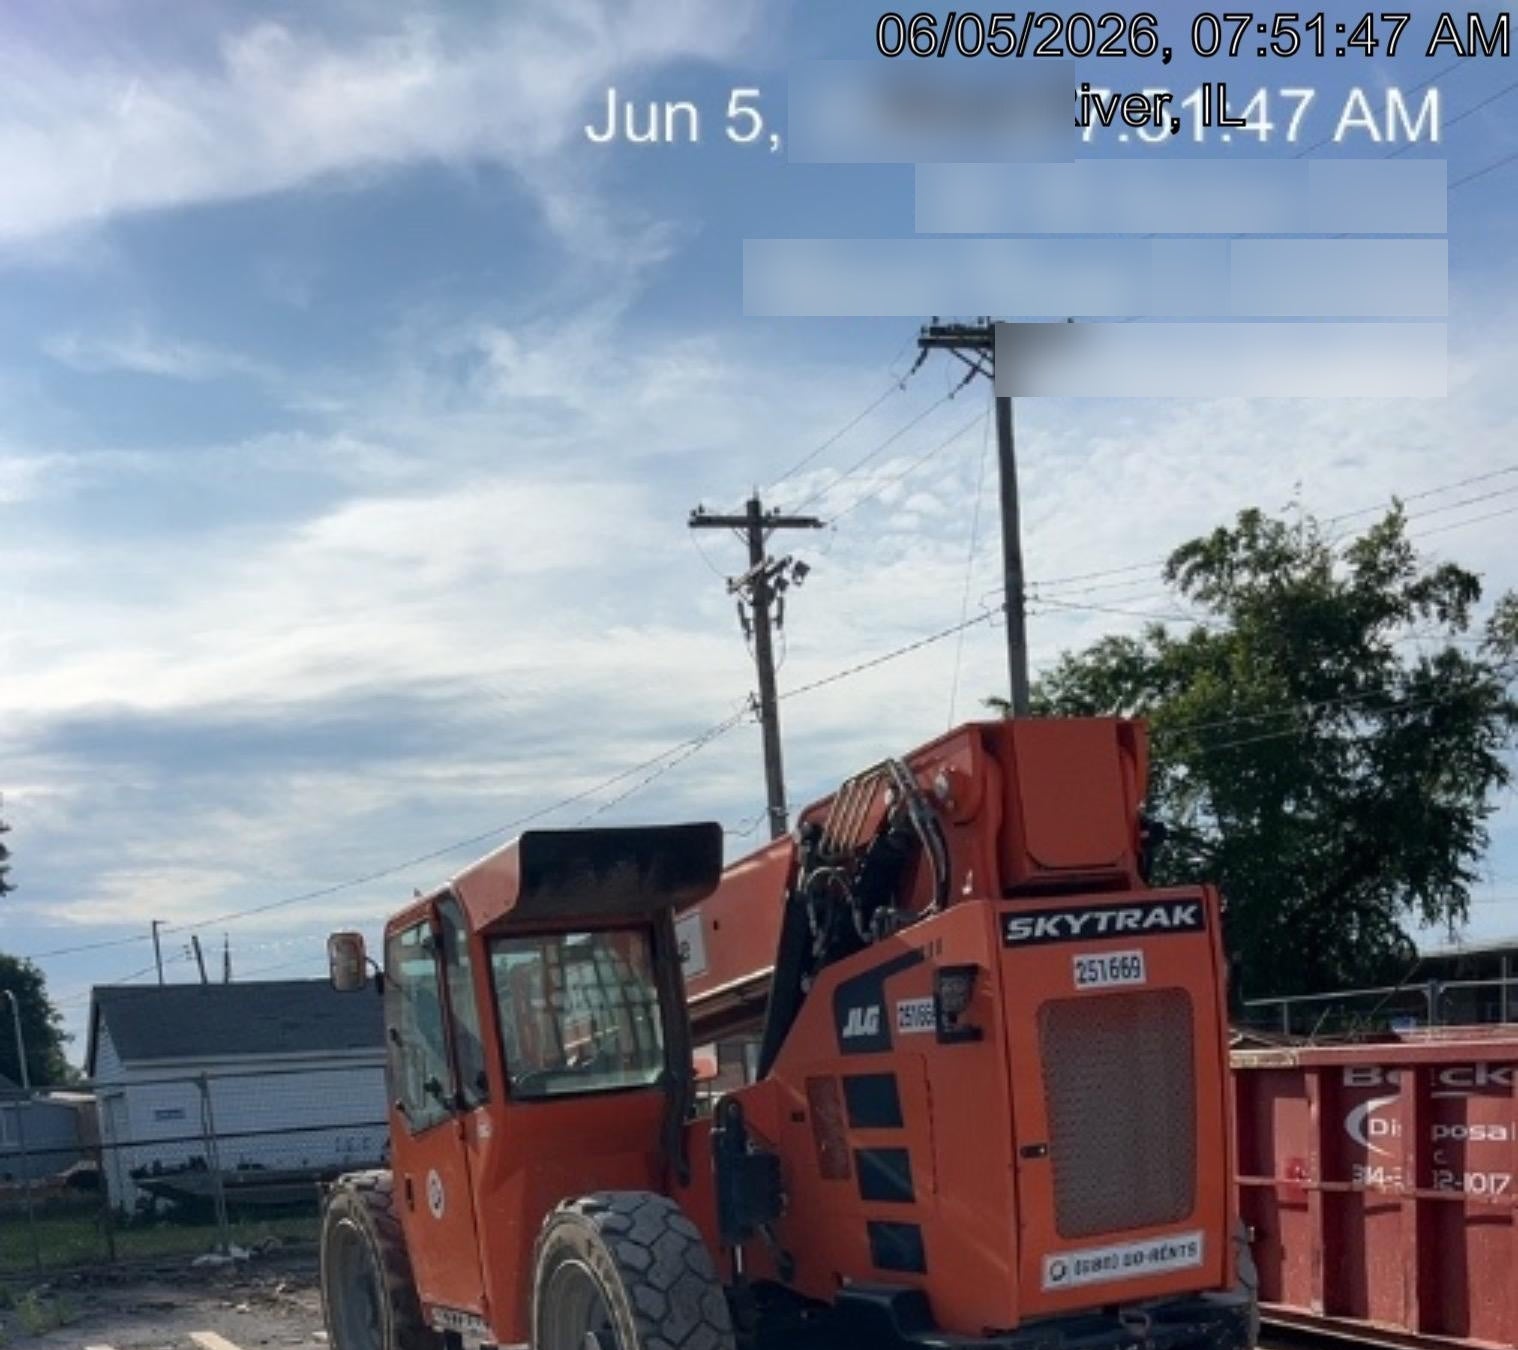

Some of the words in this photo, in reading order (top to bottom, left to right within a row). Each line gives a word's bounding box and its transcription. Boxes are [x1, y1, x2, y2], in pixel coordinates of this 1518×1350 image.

[1007, 905, 1198, 941] SKYTRAK
[1076, 955, 1141, 984] 251669
[842, 1004, 880, 1037] JLG
[1368, 1118, 1517, 1142] Diposal
